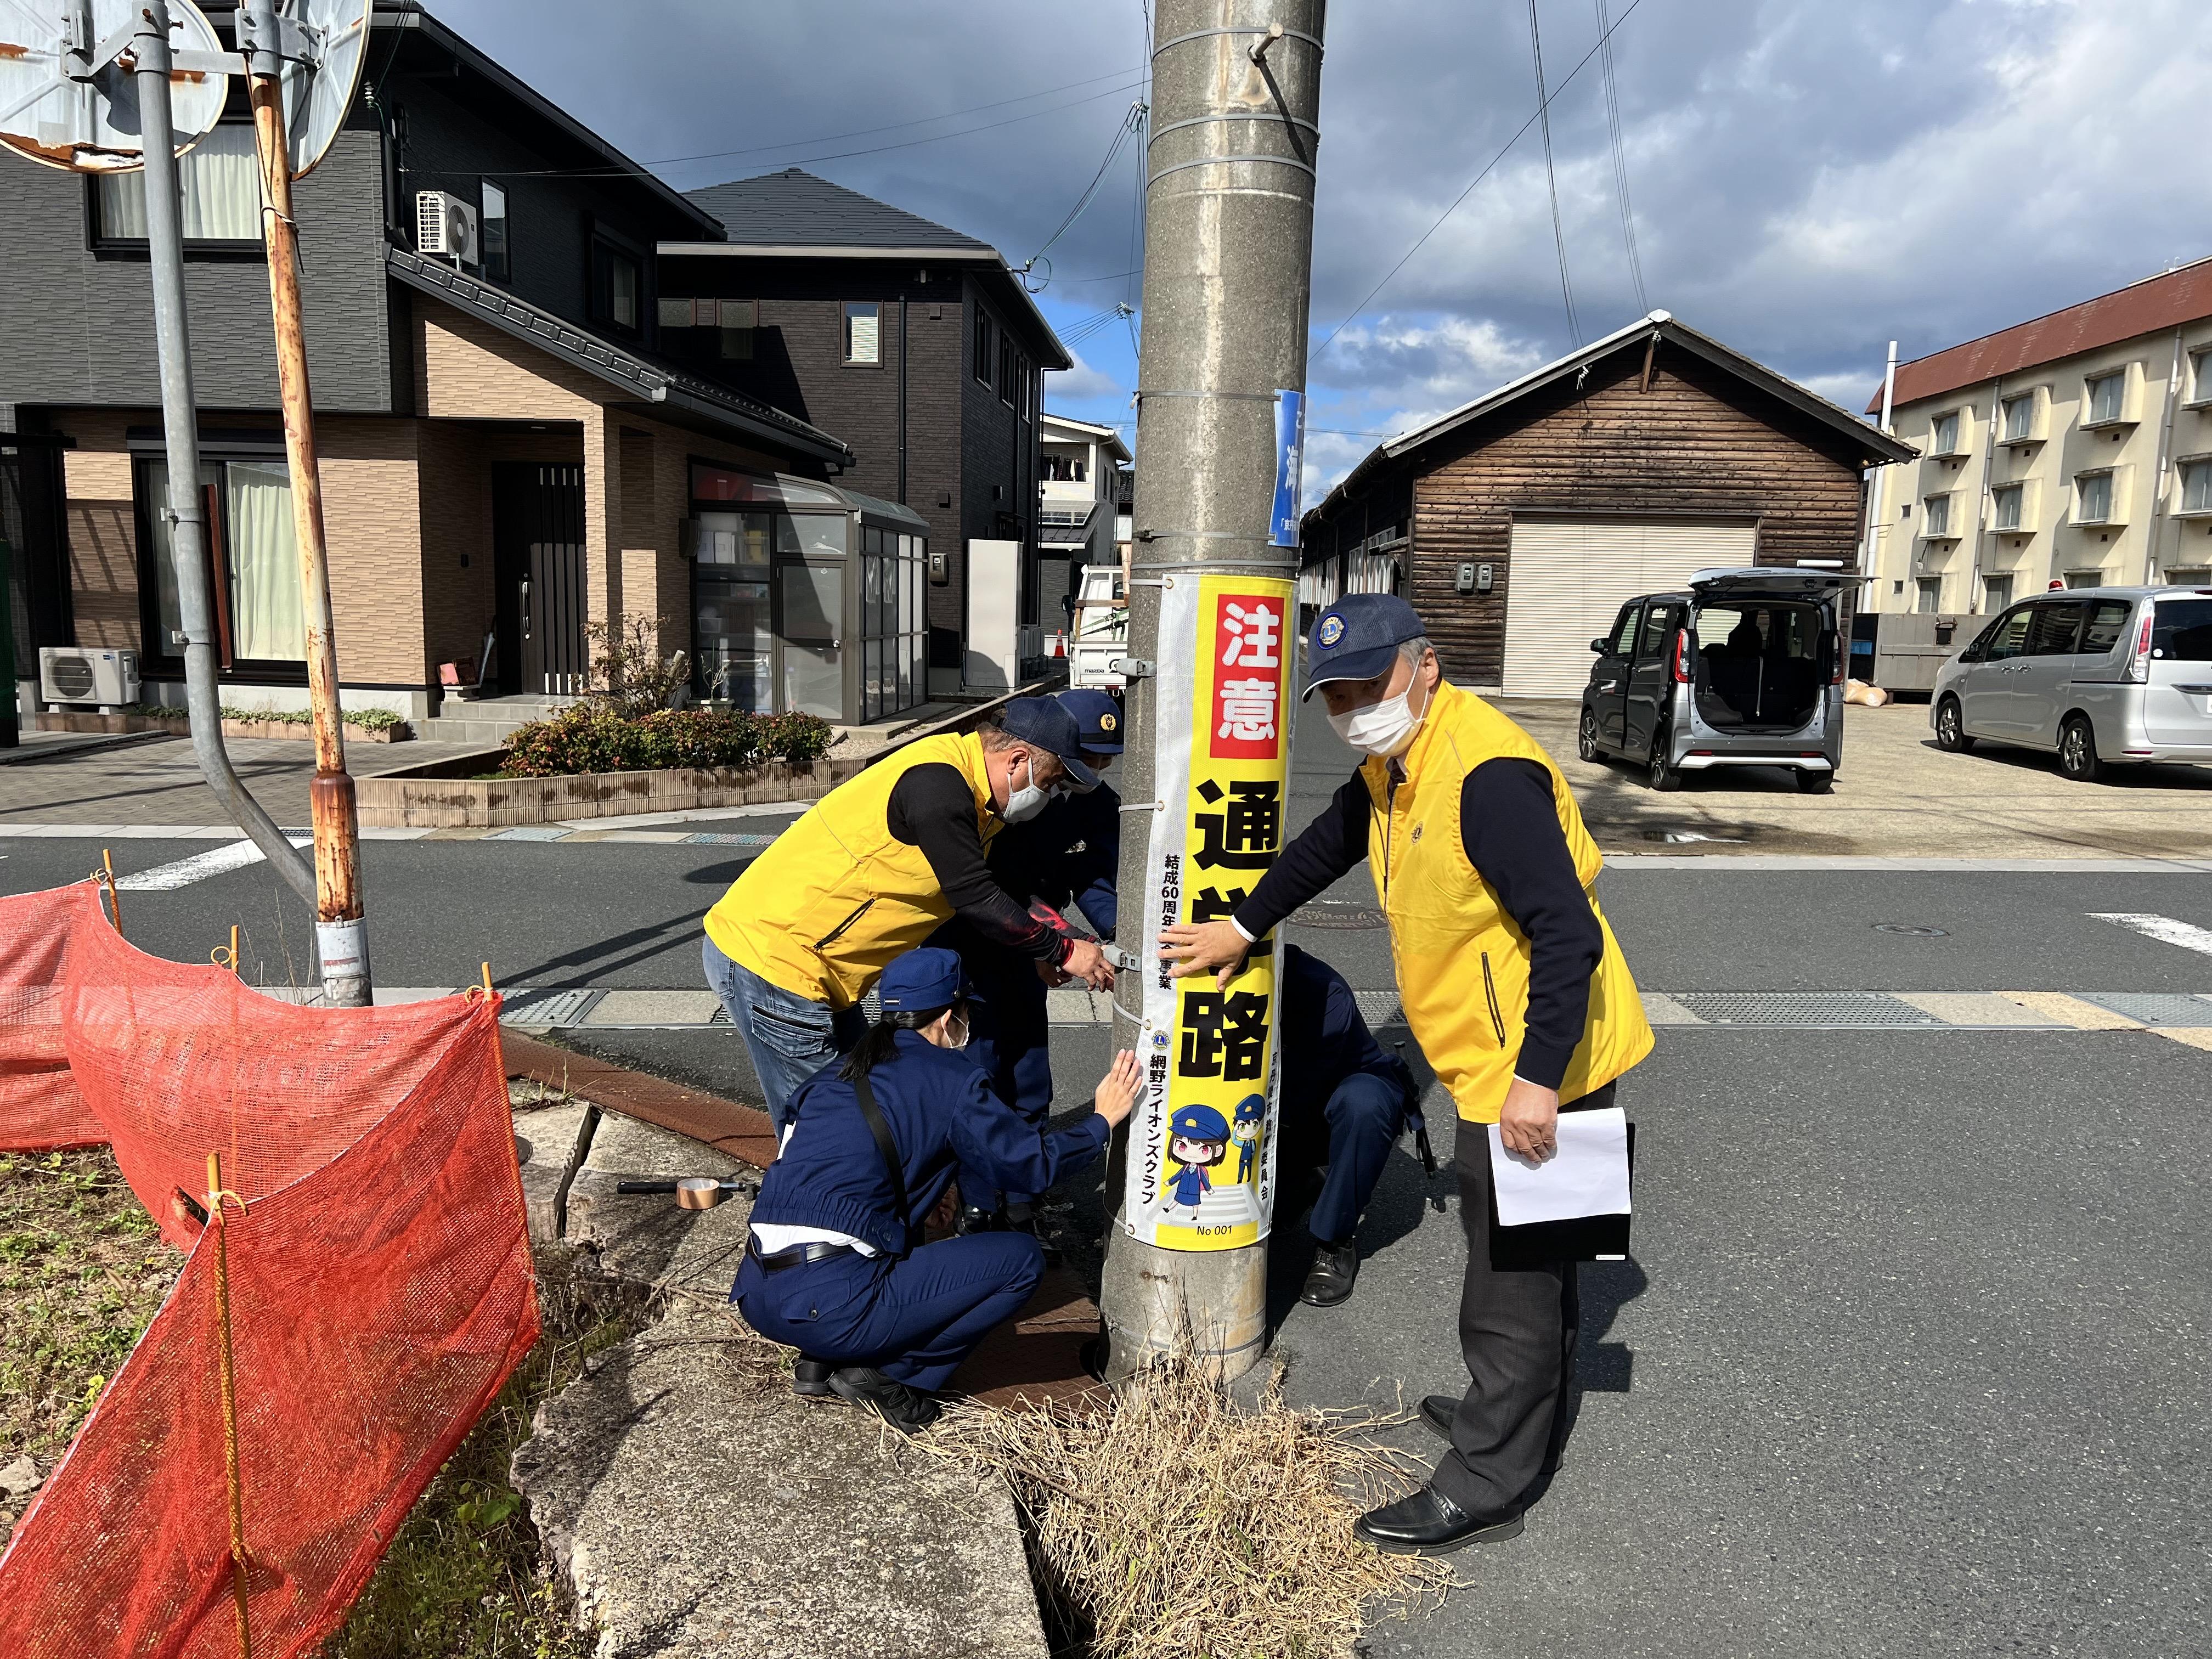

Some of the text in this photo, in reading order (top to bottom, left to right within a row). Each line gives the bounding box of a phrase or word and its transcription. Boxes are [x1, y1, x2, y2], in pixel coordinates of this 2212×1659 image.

[1217, 602, 1279, 741] 注意
[1158, 854, 1181, 990] 結成60周年事業
[1142, 1053, 1167, 1205] 網野ライオンズクラブ
[1197, 1225, 1232, 1235] No 001
